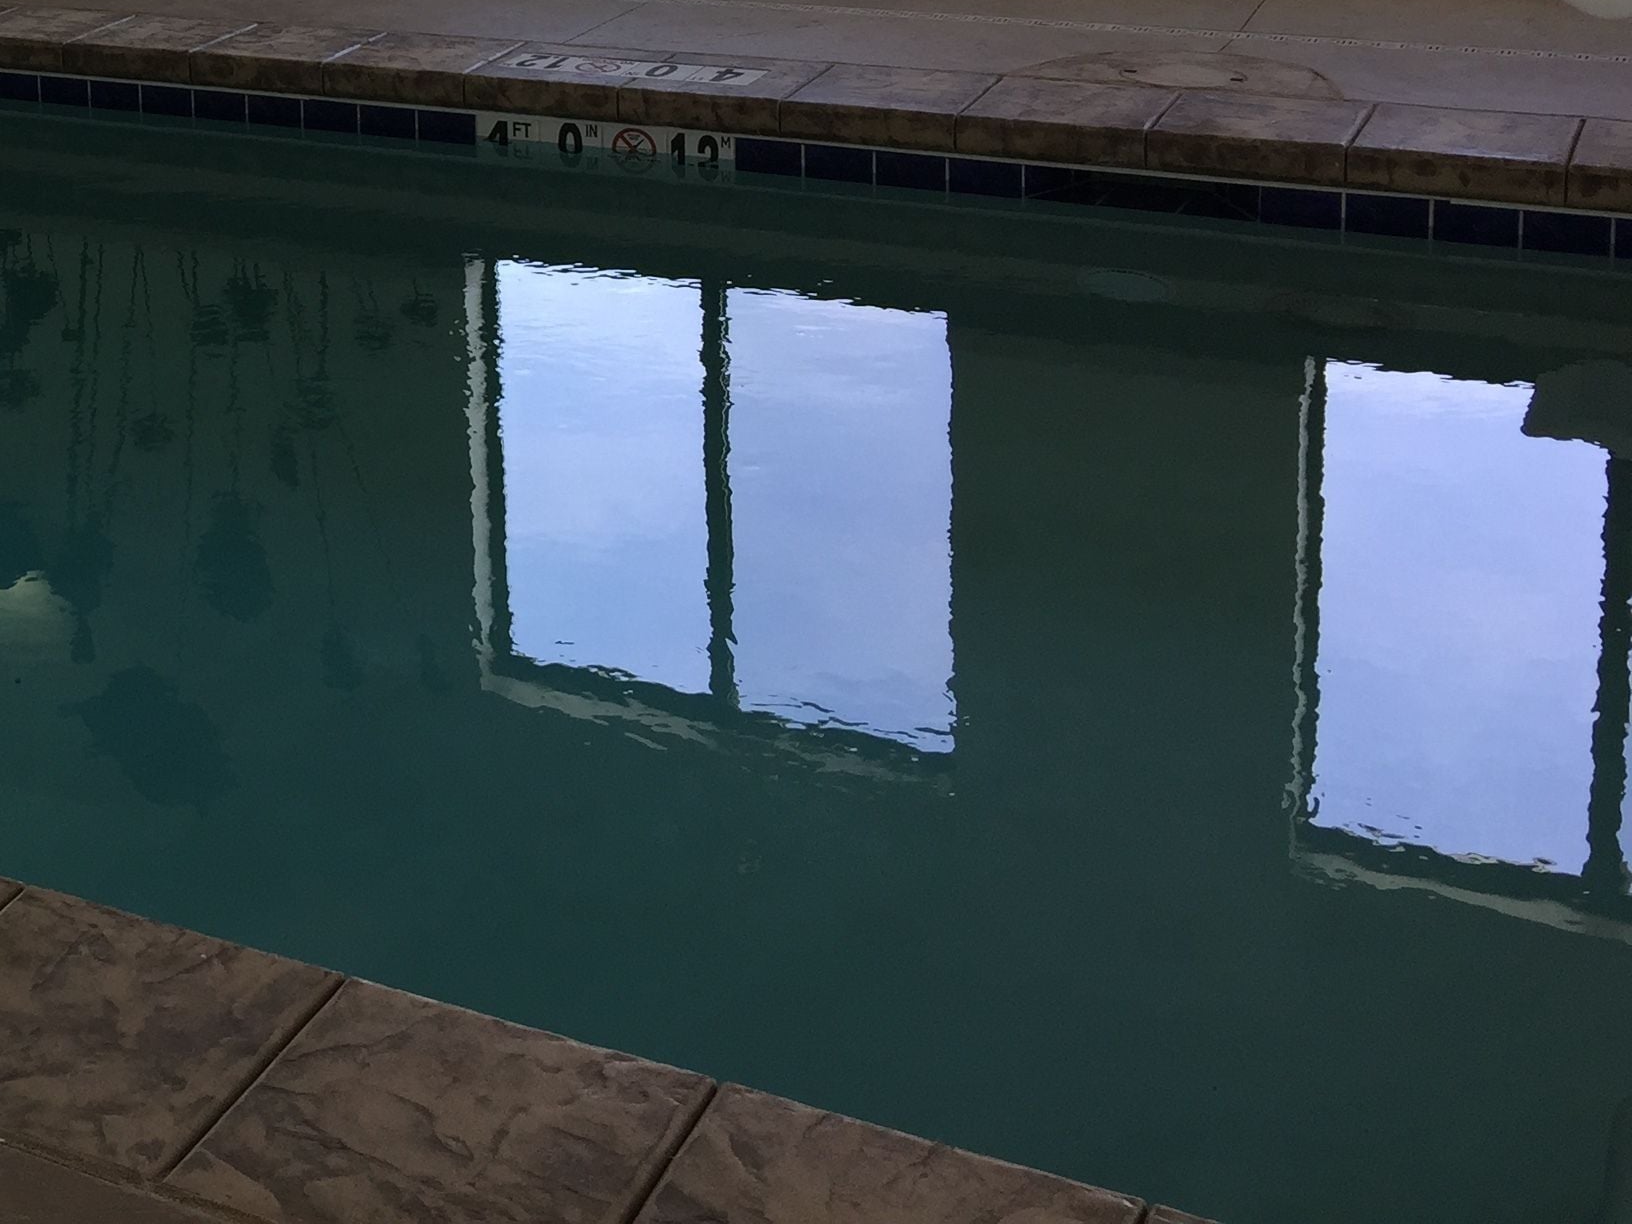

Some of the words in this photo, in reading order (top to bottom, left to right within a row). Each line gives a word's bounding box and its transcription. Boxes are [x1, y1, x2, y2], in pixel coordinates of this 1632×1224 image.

[512, 122, 532, 139] FT
[586, 124, 598, 138] IN
[721, 137, 731, 149] M
